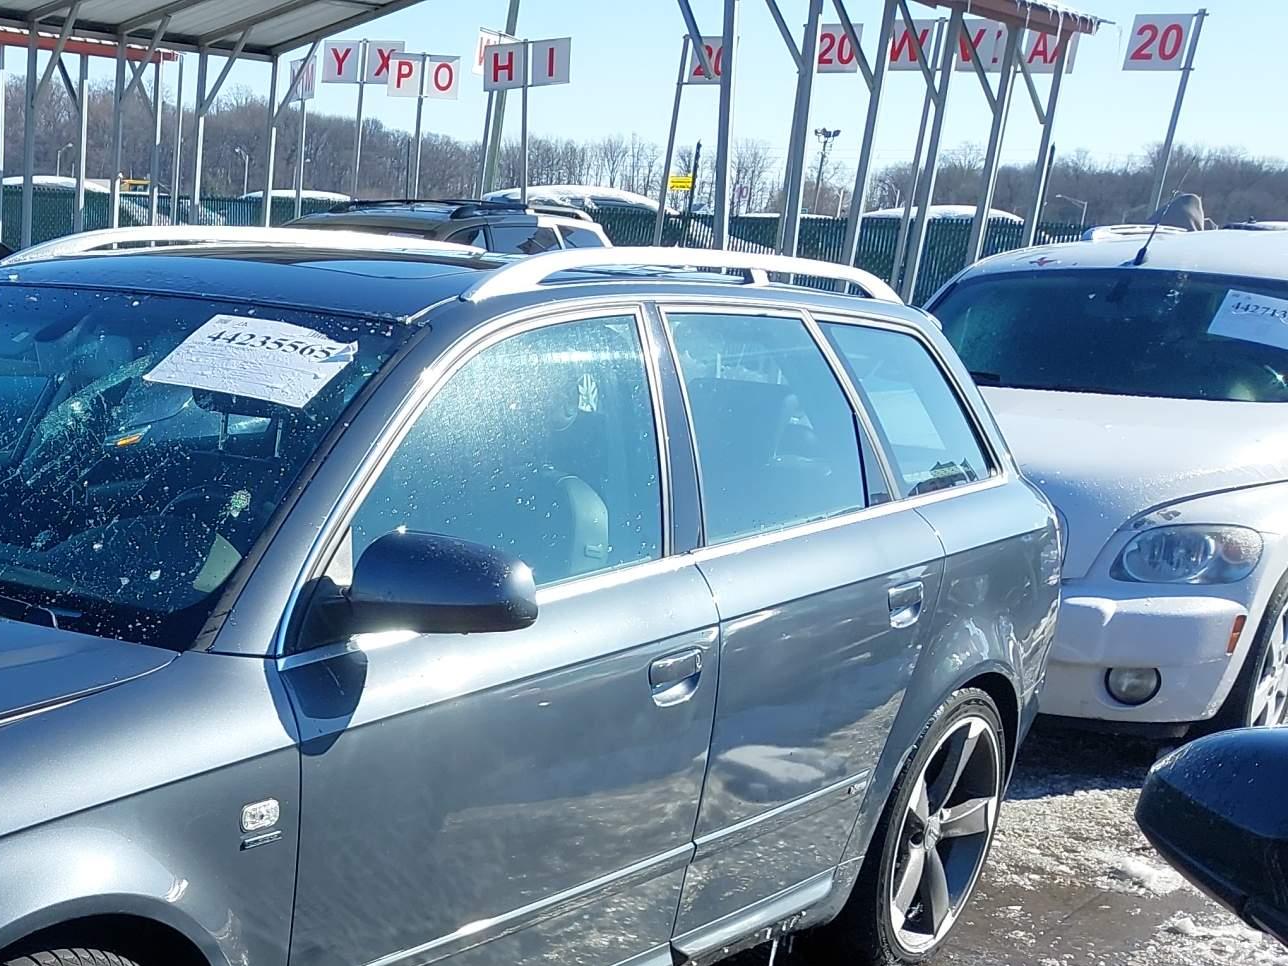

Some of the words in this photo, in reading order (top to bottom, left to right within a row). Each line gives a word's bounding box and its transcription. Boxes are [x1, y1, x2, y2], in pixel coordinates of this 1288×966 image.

[818, 32, 854, 65] 20
[1130, 24, 1184, 61] 20
[330, 47, 352, 75] Y
[374, 48, 395, 76] X
[396, 60, 413, 89] P
[493, 51, 513, 82] H
[547, 47, 555, 77] I
[207, 329, 337, 360] 44235565
